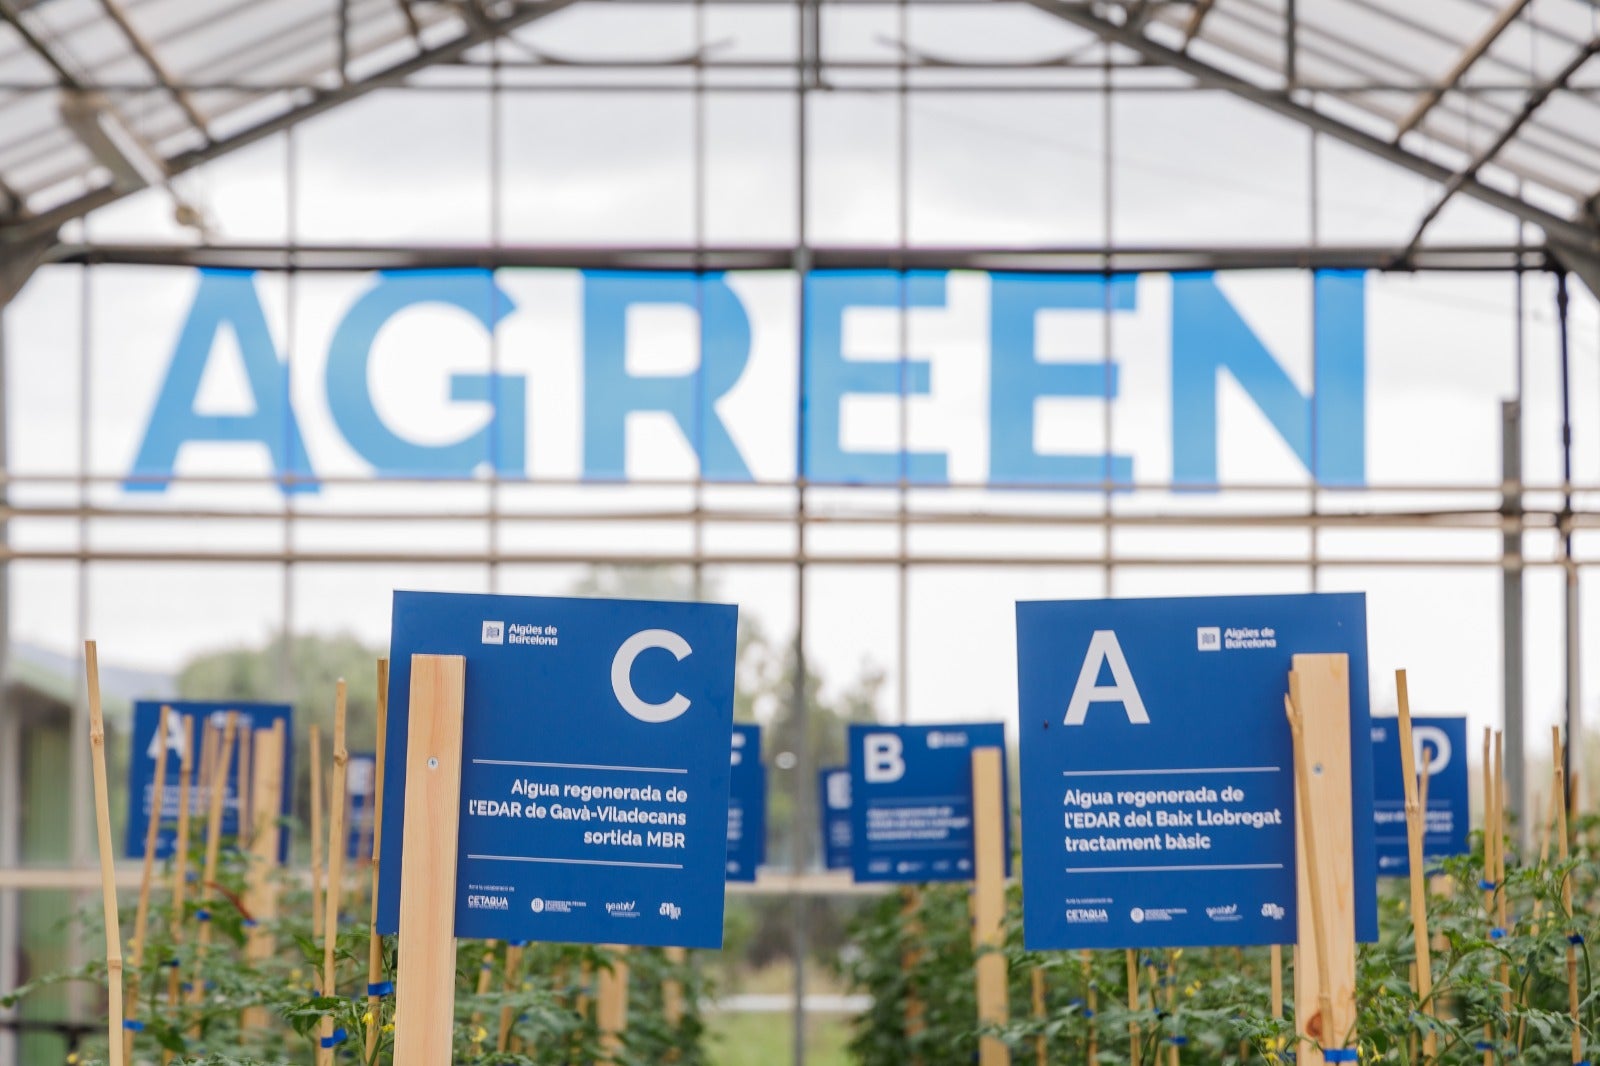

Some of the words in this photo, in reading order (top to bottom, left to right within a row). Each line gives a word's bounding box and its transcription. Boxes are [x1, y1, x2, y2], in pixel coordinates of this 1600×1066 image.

[122, 267, 1367, 493] AGREEN
[508, 623, 542, 637] Aigües
[544, 624, 558, 636] de
[508, 634, 558, 646] Barcelona
[1224, 627, 1258, 641] Aigües
[1260, 627, 1276, 638] de
[1224, 636, 1277, 649] Barcelona
[610, 628, 693, 723] C
[1063, 629, 1150, 726] A
[146, 709, 187, 760] A
[863, 732, 906, 785] B
[1411, 726, 1452, 776] D
[511, 779, 560, 801] Aigua
[563, 782, 661, 804] regenerada
[665, 785, 688, 803] de
[1063, 788, 1114, 810] Aigua
[1117, 786, 1218, 809] regenerada
[1221, 786, 1245, 803] de
[468, 799, 521, 818] l'EDAR
[525, 801, 546, 819] de
[550, 803, 687, 826] Gavà-Viladecans
[1064, 810, 1121, 829] l'EDAR
[1124, 809, 1153, 828] del
[1156, 809, 1194, 827] Baix
[1196, 807, 1282, 830] Llobregat
[583, 828, 643, 847] sortida
[646, 831, 685, 848] MBR
[1065, 834, 1161, 853] tractament
[1165, 832, 1211, 850] bàsic
[467, 895, 508, 907] CETAQUA
[1065, 908, 1108, 920] CETAQUA
